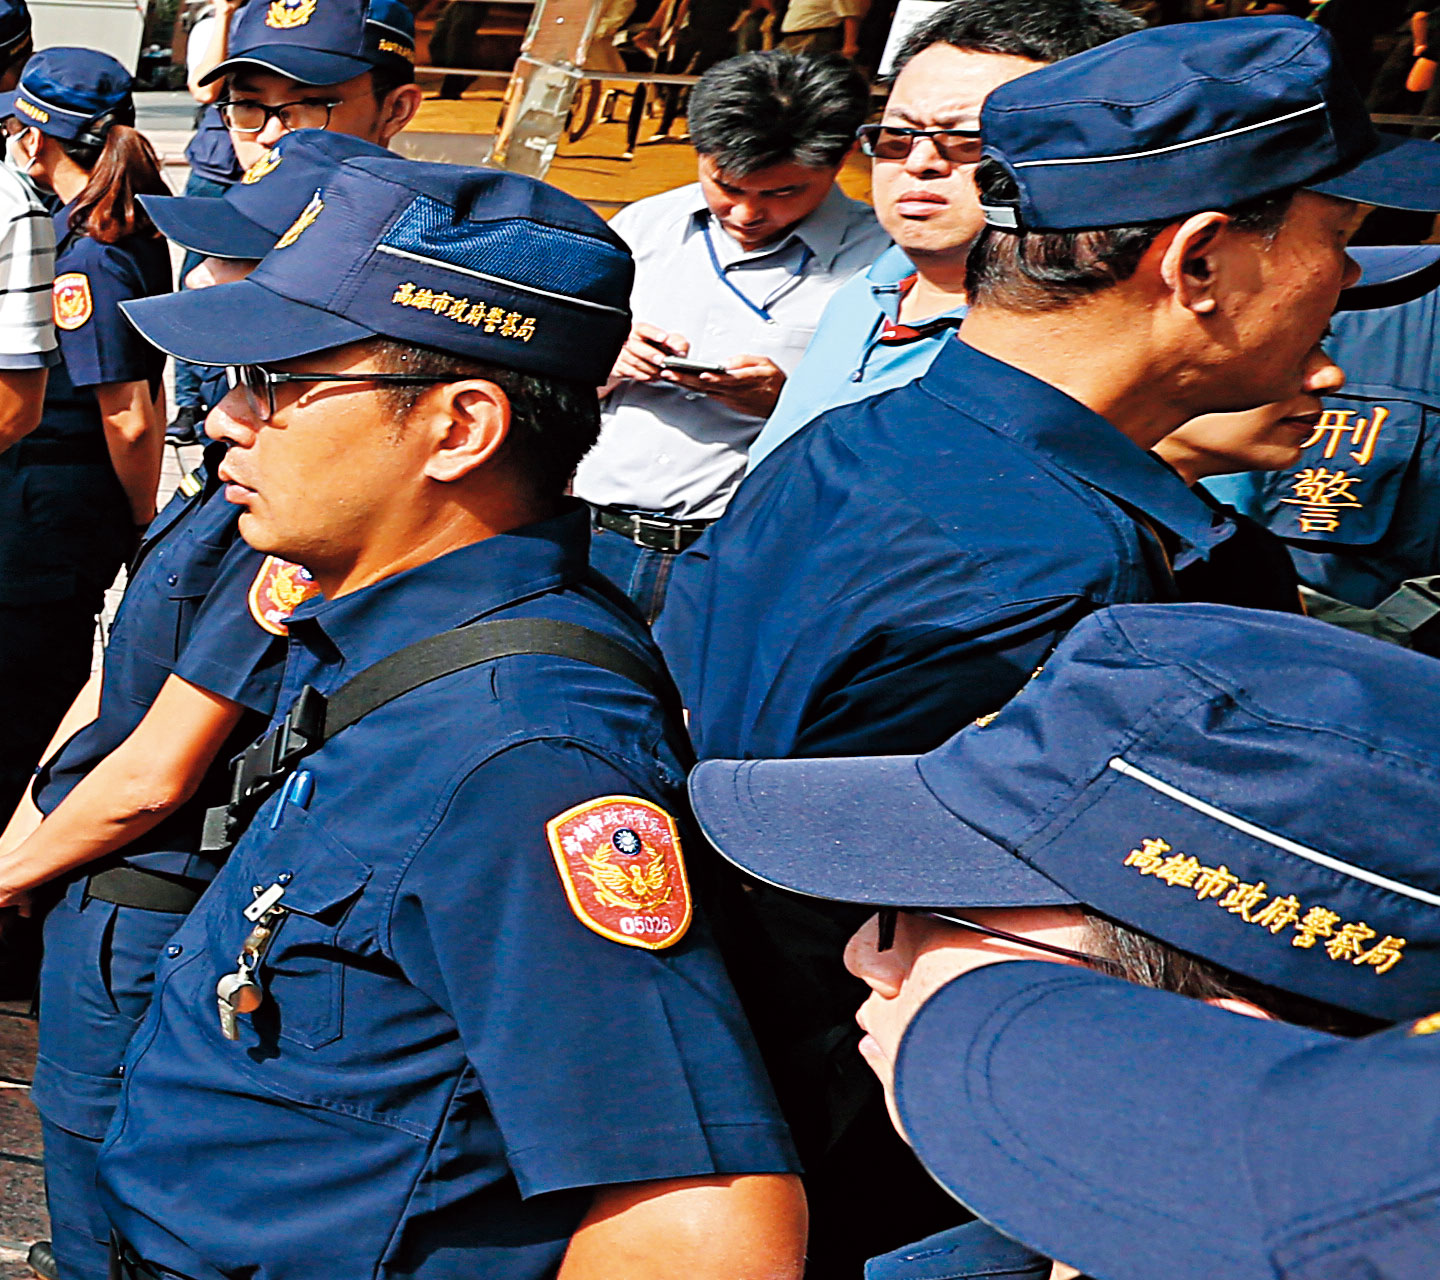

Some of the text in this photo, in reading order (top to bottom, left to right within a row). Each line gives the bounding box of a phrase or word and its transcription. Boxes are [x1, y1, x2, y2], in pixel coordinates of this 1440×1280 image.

[391, 281, 537, 343] 高雄市政府警察局
[1280, 406, 1391, 533] 刑警
[619, 916, 673, 935] 05026
[1123, 837, 1408, 975] 高雄市政府警察局
